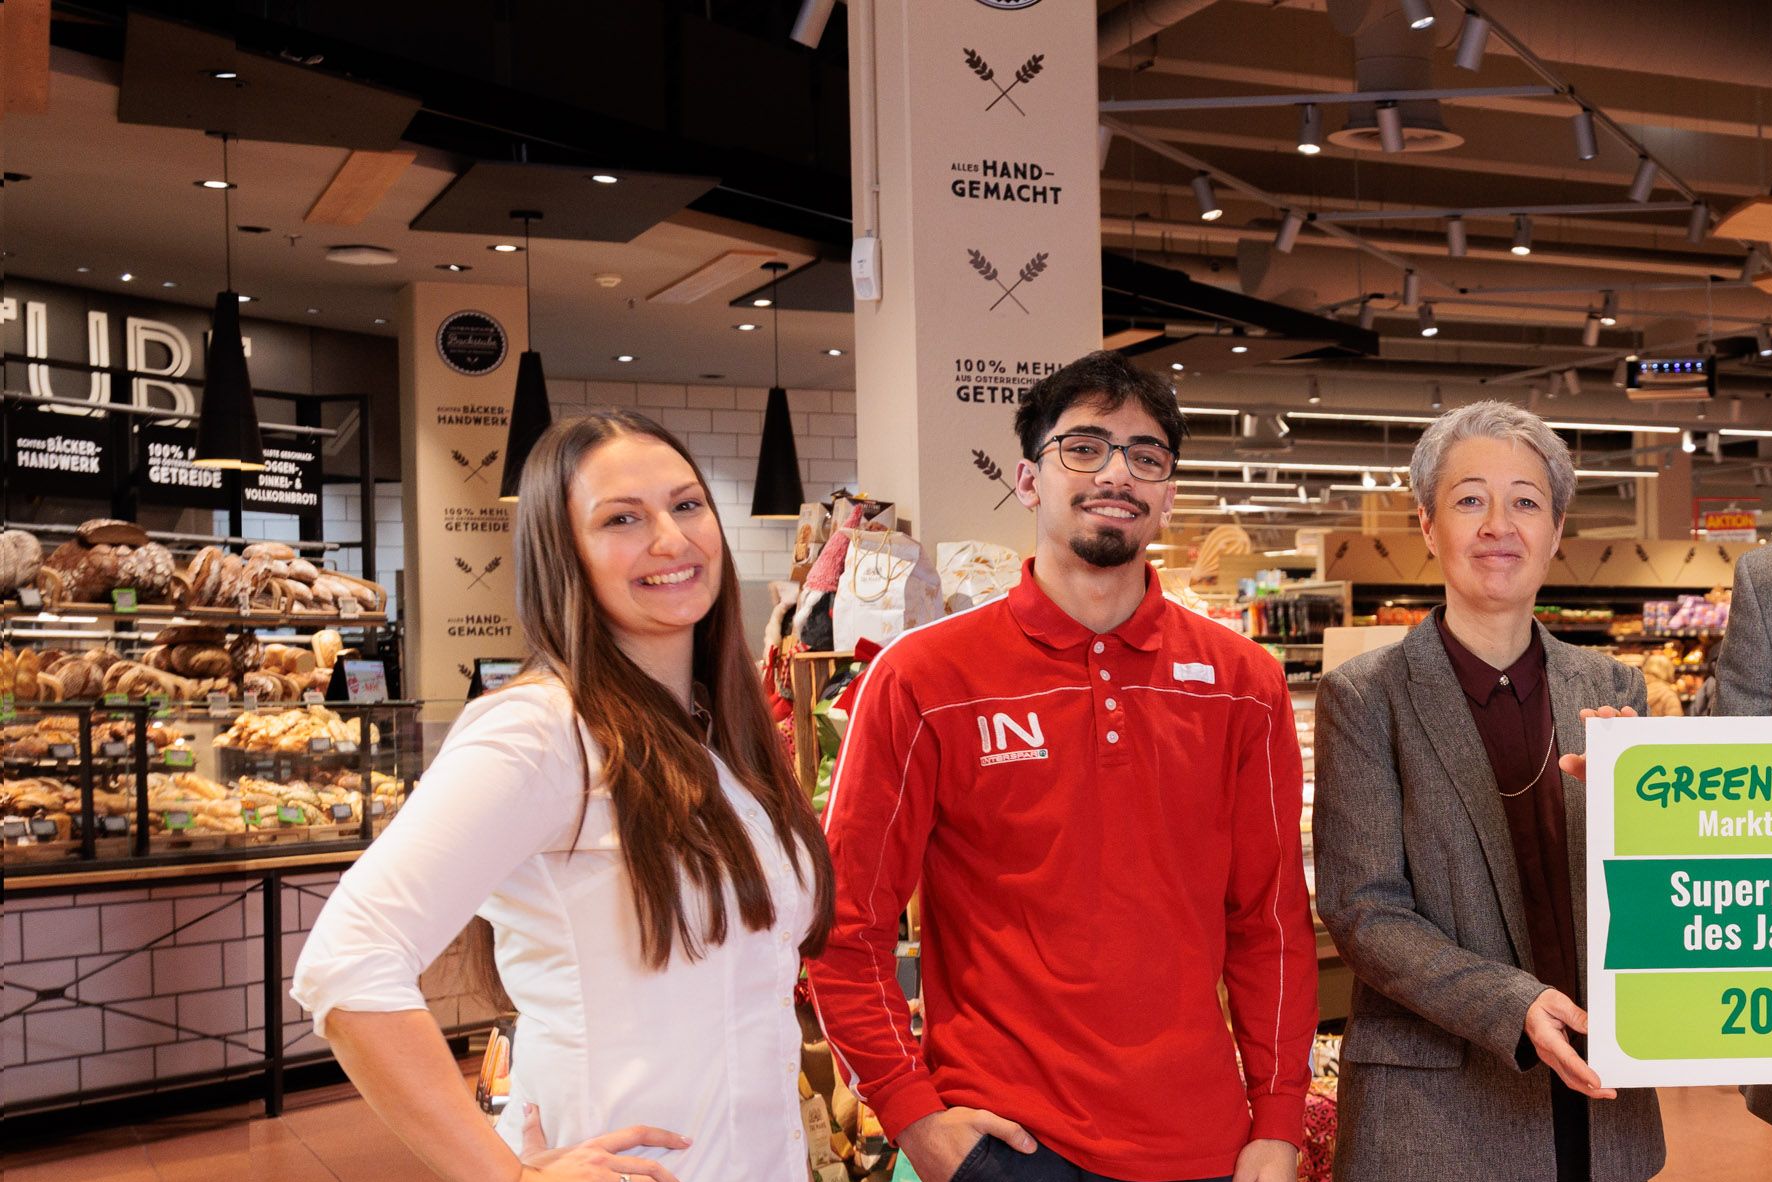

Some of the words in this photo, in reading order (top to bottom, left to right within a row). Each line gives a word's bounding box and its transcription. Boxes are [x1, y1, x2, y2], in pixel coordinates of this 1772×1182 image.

[951, 162, 979, 172] ALLES
[982, 160, 1055, 180] HAND-
[951, 179, 1062, 205] GEMACHT
[955, 359, 1006, 374] 100%
[437, 415, 508, 426] HANDWERK
[47, 435, 103, 456] BÄCKER-
[148, 442, 184, 459] 100%
[17, 451, 100, 474] HANDWERK
[264, 459, 303, 475] OGGEN-,
[149, 466, 222, 488] GETREIDE
[258, 474, 292, 488] DINKEL-
[294, 477, 303, 490] &
[245, 487, 317, 506] VOLLKORNBROT!
[444, 507, 474, 516] 100%
[480, 507, 508, 516] MEHL
[445, 521, 510, 532] GETREIDE
[1707, 515, 1756, 529] AKTION
[447, 625, 513, 636] GEMACHT
[977, 711, 1045, 753] IN
[1683, 915, 1742, 951] des
